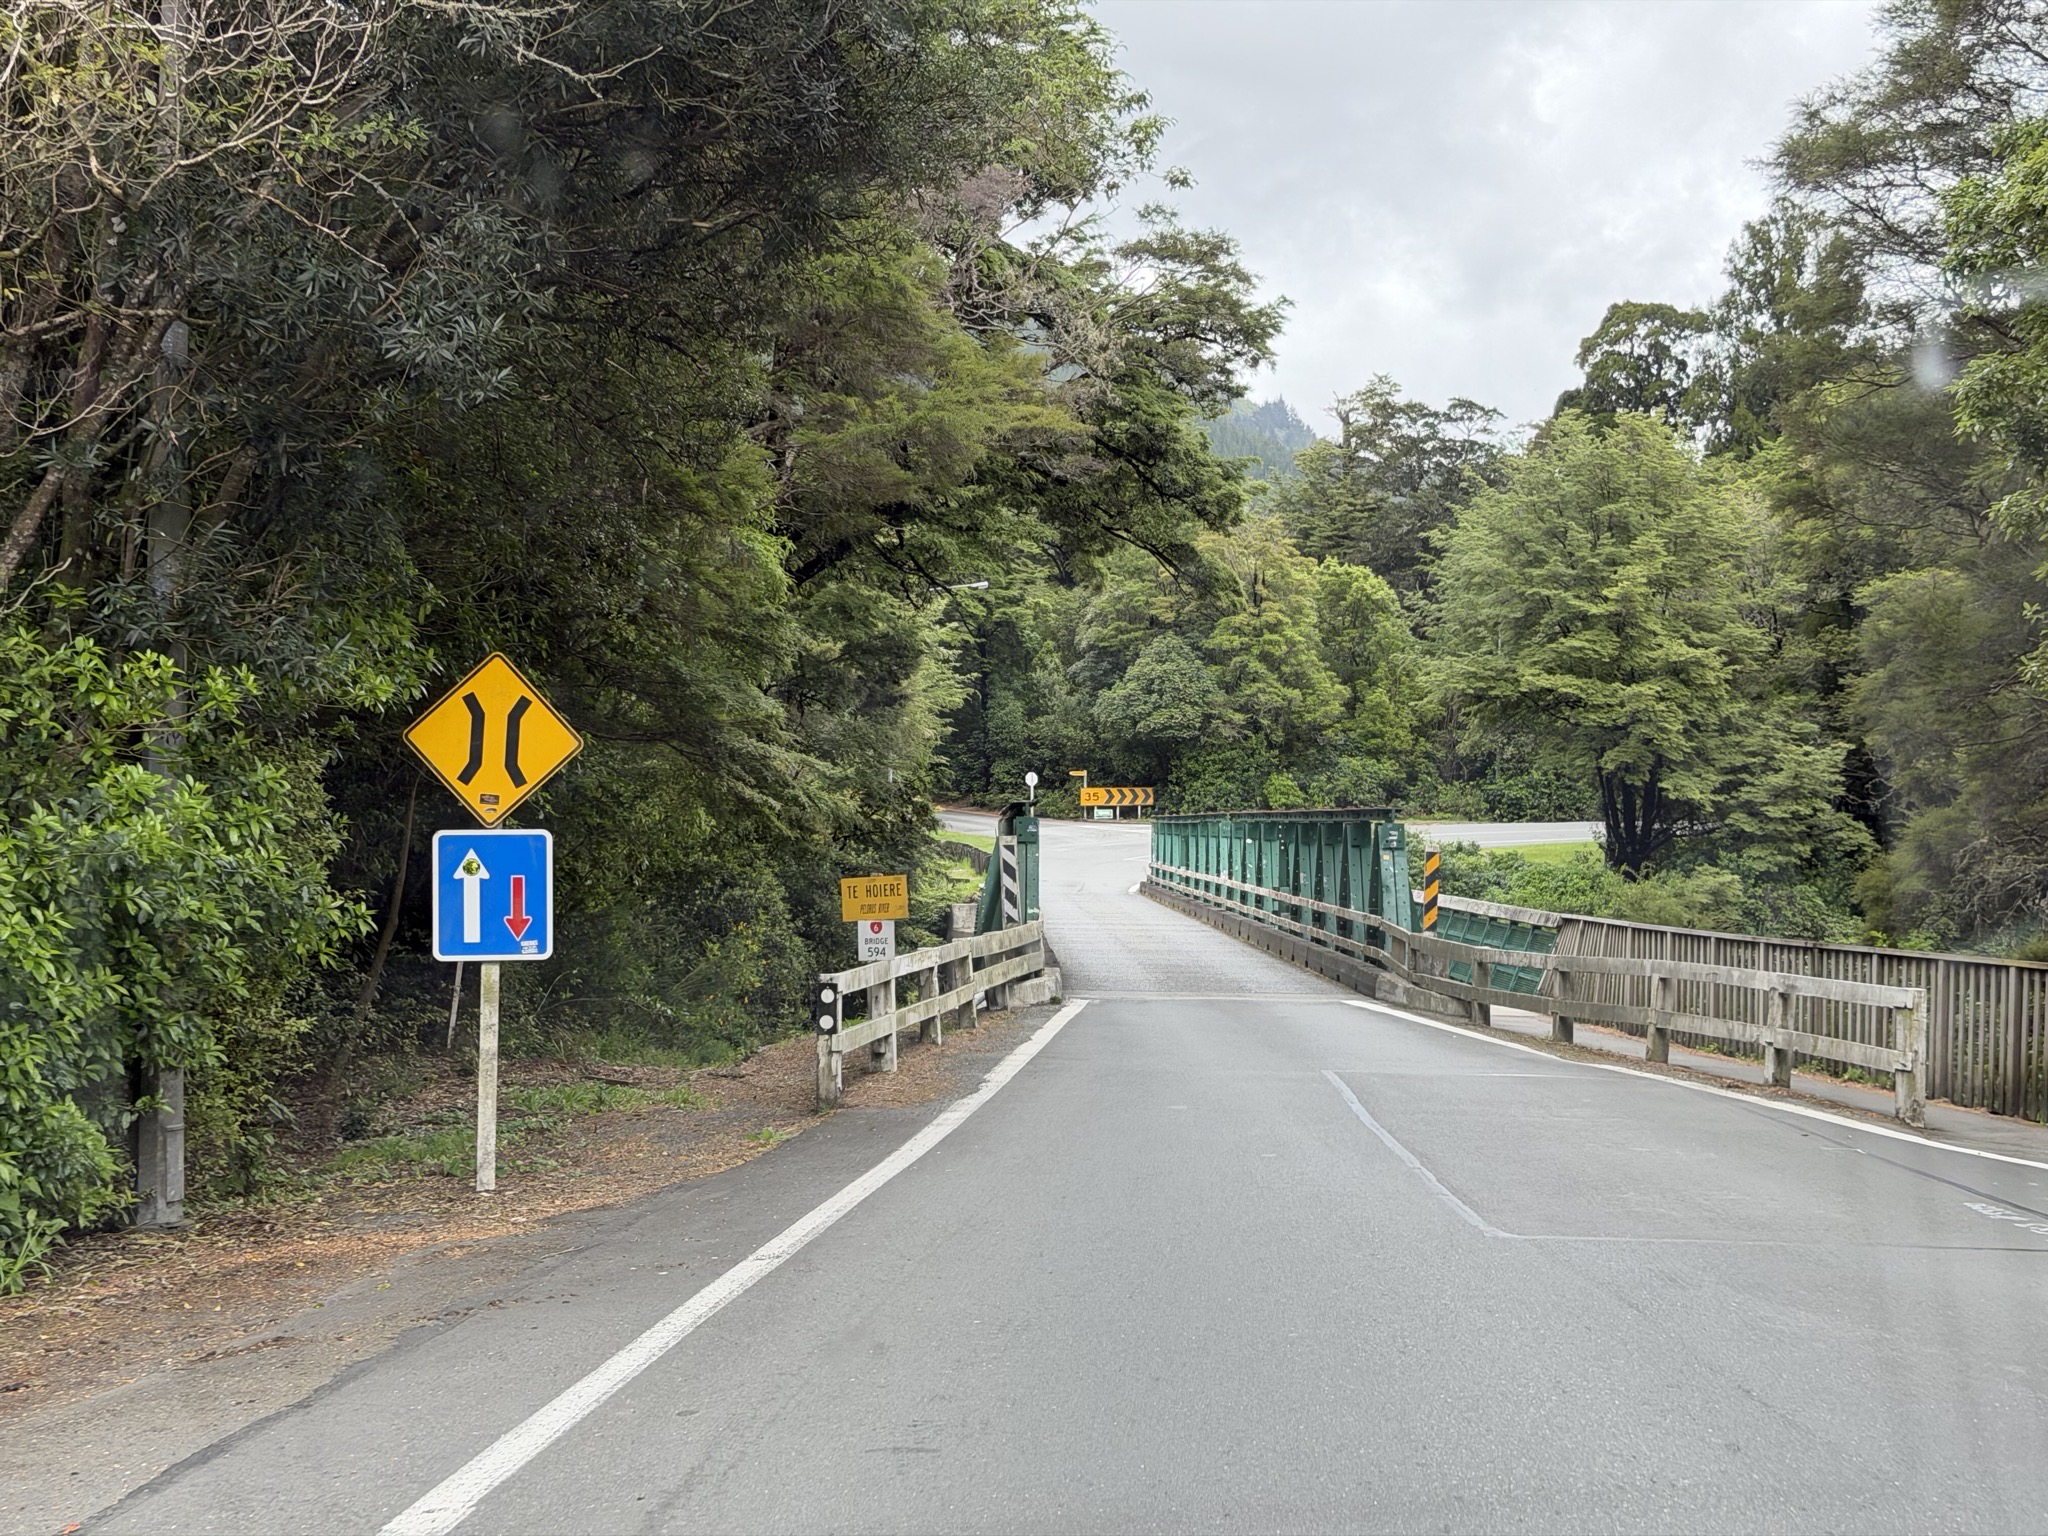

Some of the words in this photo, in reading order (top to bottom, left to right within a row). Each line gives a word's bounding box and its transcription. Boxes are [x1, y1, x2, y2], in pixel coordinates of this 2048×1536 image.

[1084, 792, 1099, 801] 35
[847, 885, 859, 899] TE
[865, 883, 902, 898] HOIERE
[878, 903, 890, 913] RIVER
[873, 924, 879, 932] 6
[864, 937, 889, 945] BRIDGE
[867, 947, 886, 957] 594
